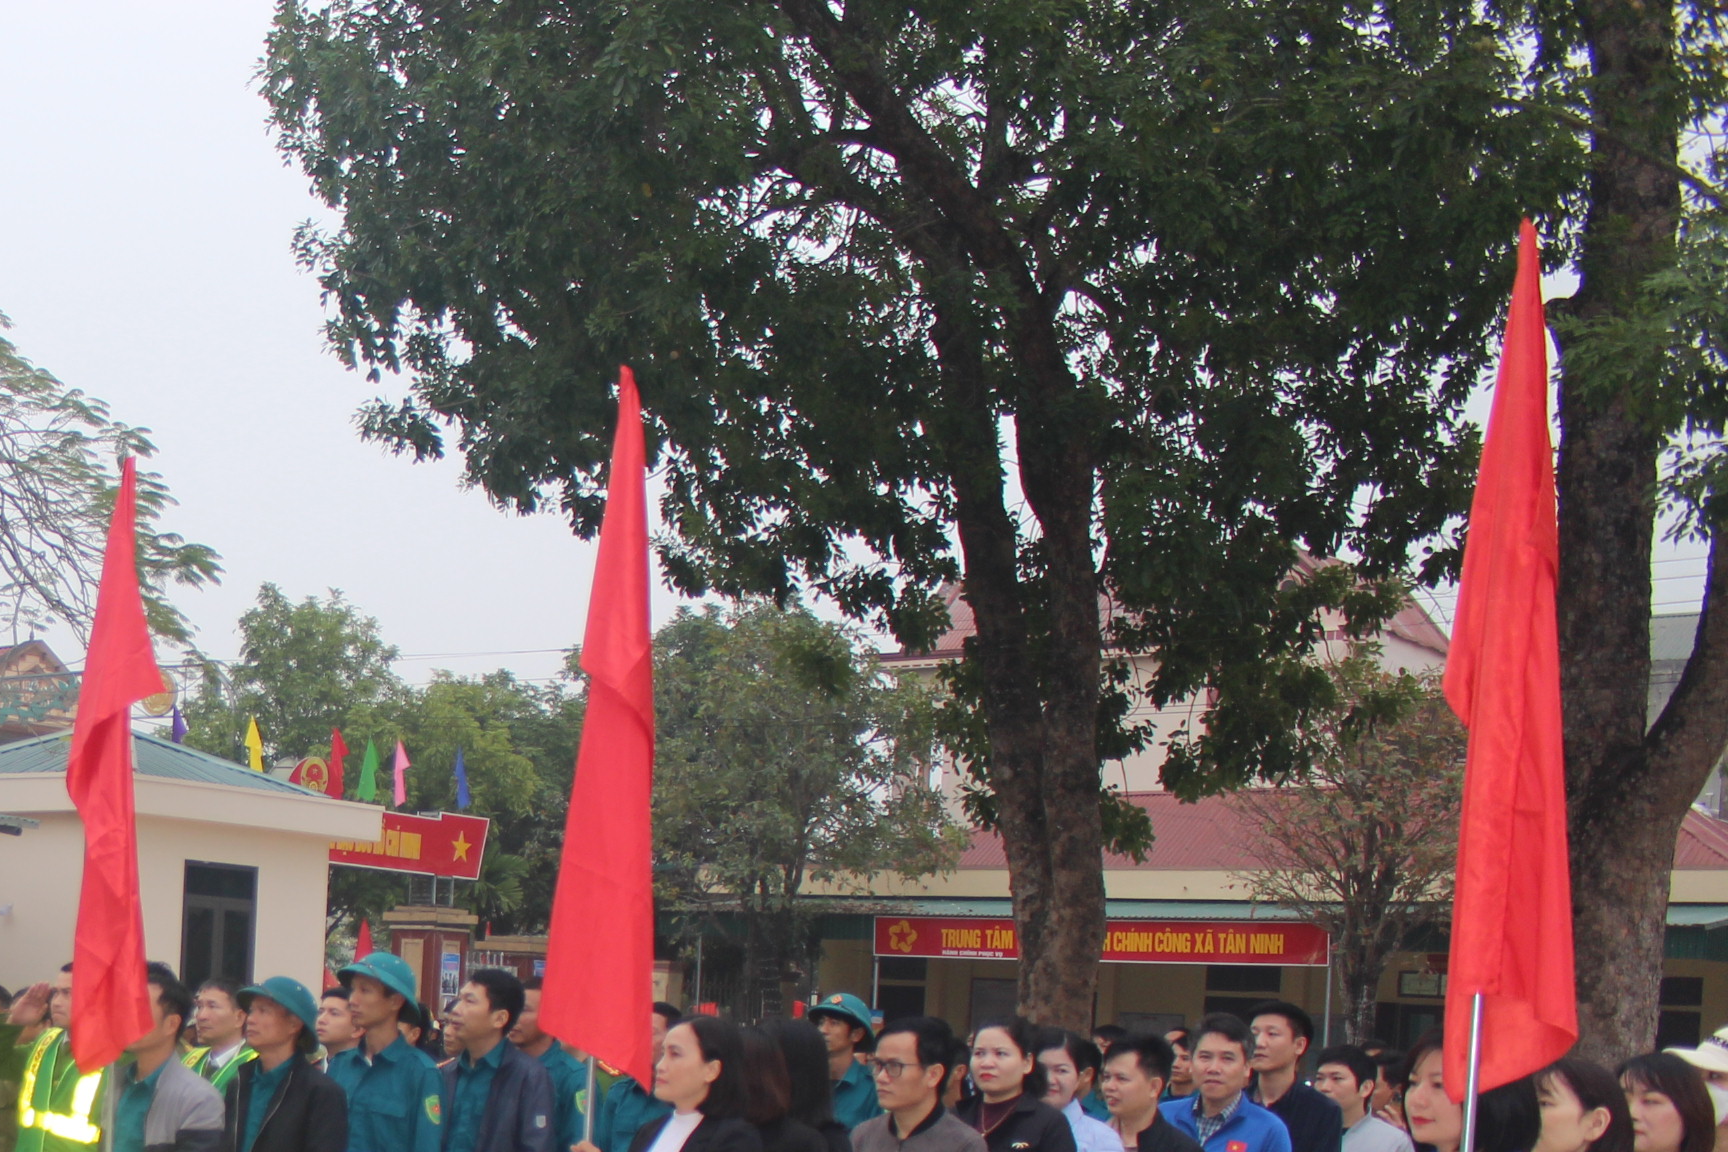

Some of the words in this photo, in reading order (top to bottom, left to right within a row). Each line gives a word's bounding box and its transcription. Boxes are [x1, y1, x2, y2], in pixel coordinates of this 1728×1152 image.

[941, 928, 981, 948] TRUNG
[985, 925, 1013, 949] TÂM
[1113, 927, 1153, 952] CHÍNH
[1154, 928, 1191, 953] CÔNG
[1194, 928, 1215, 953] XÃ
[1218, 928, 1246, 954] TÂN
[1250, 933, 1284, 954] NINH
